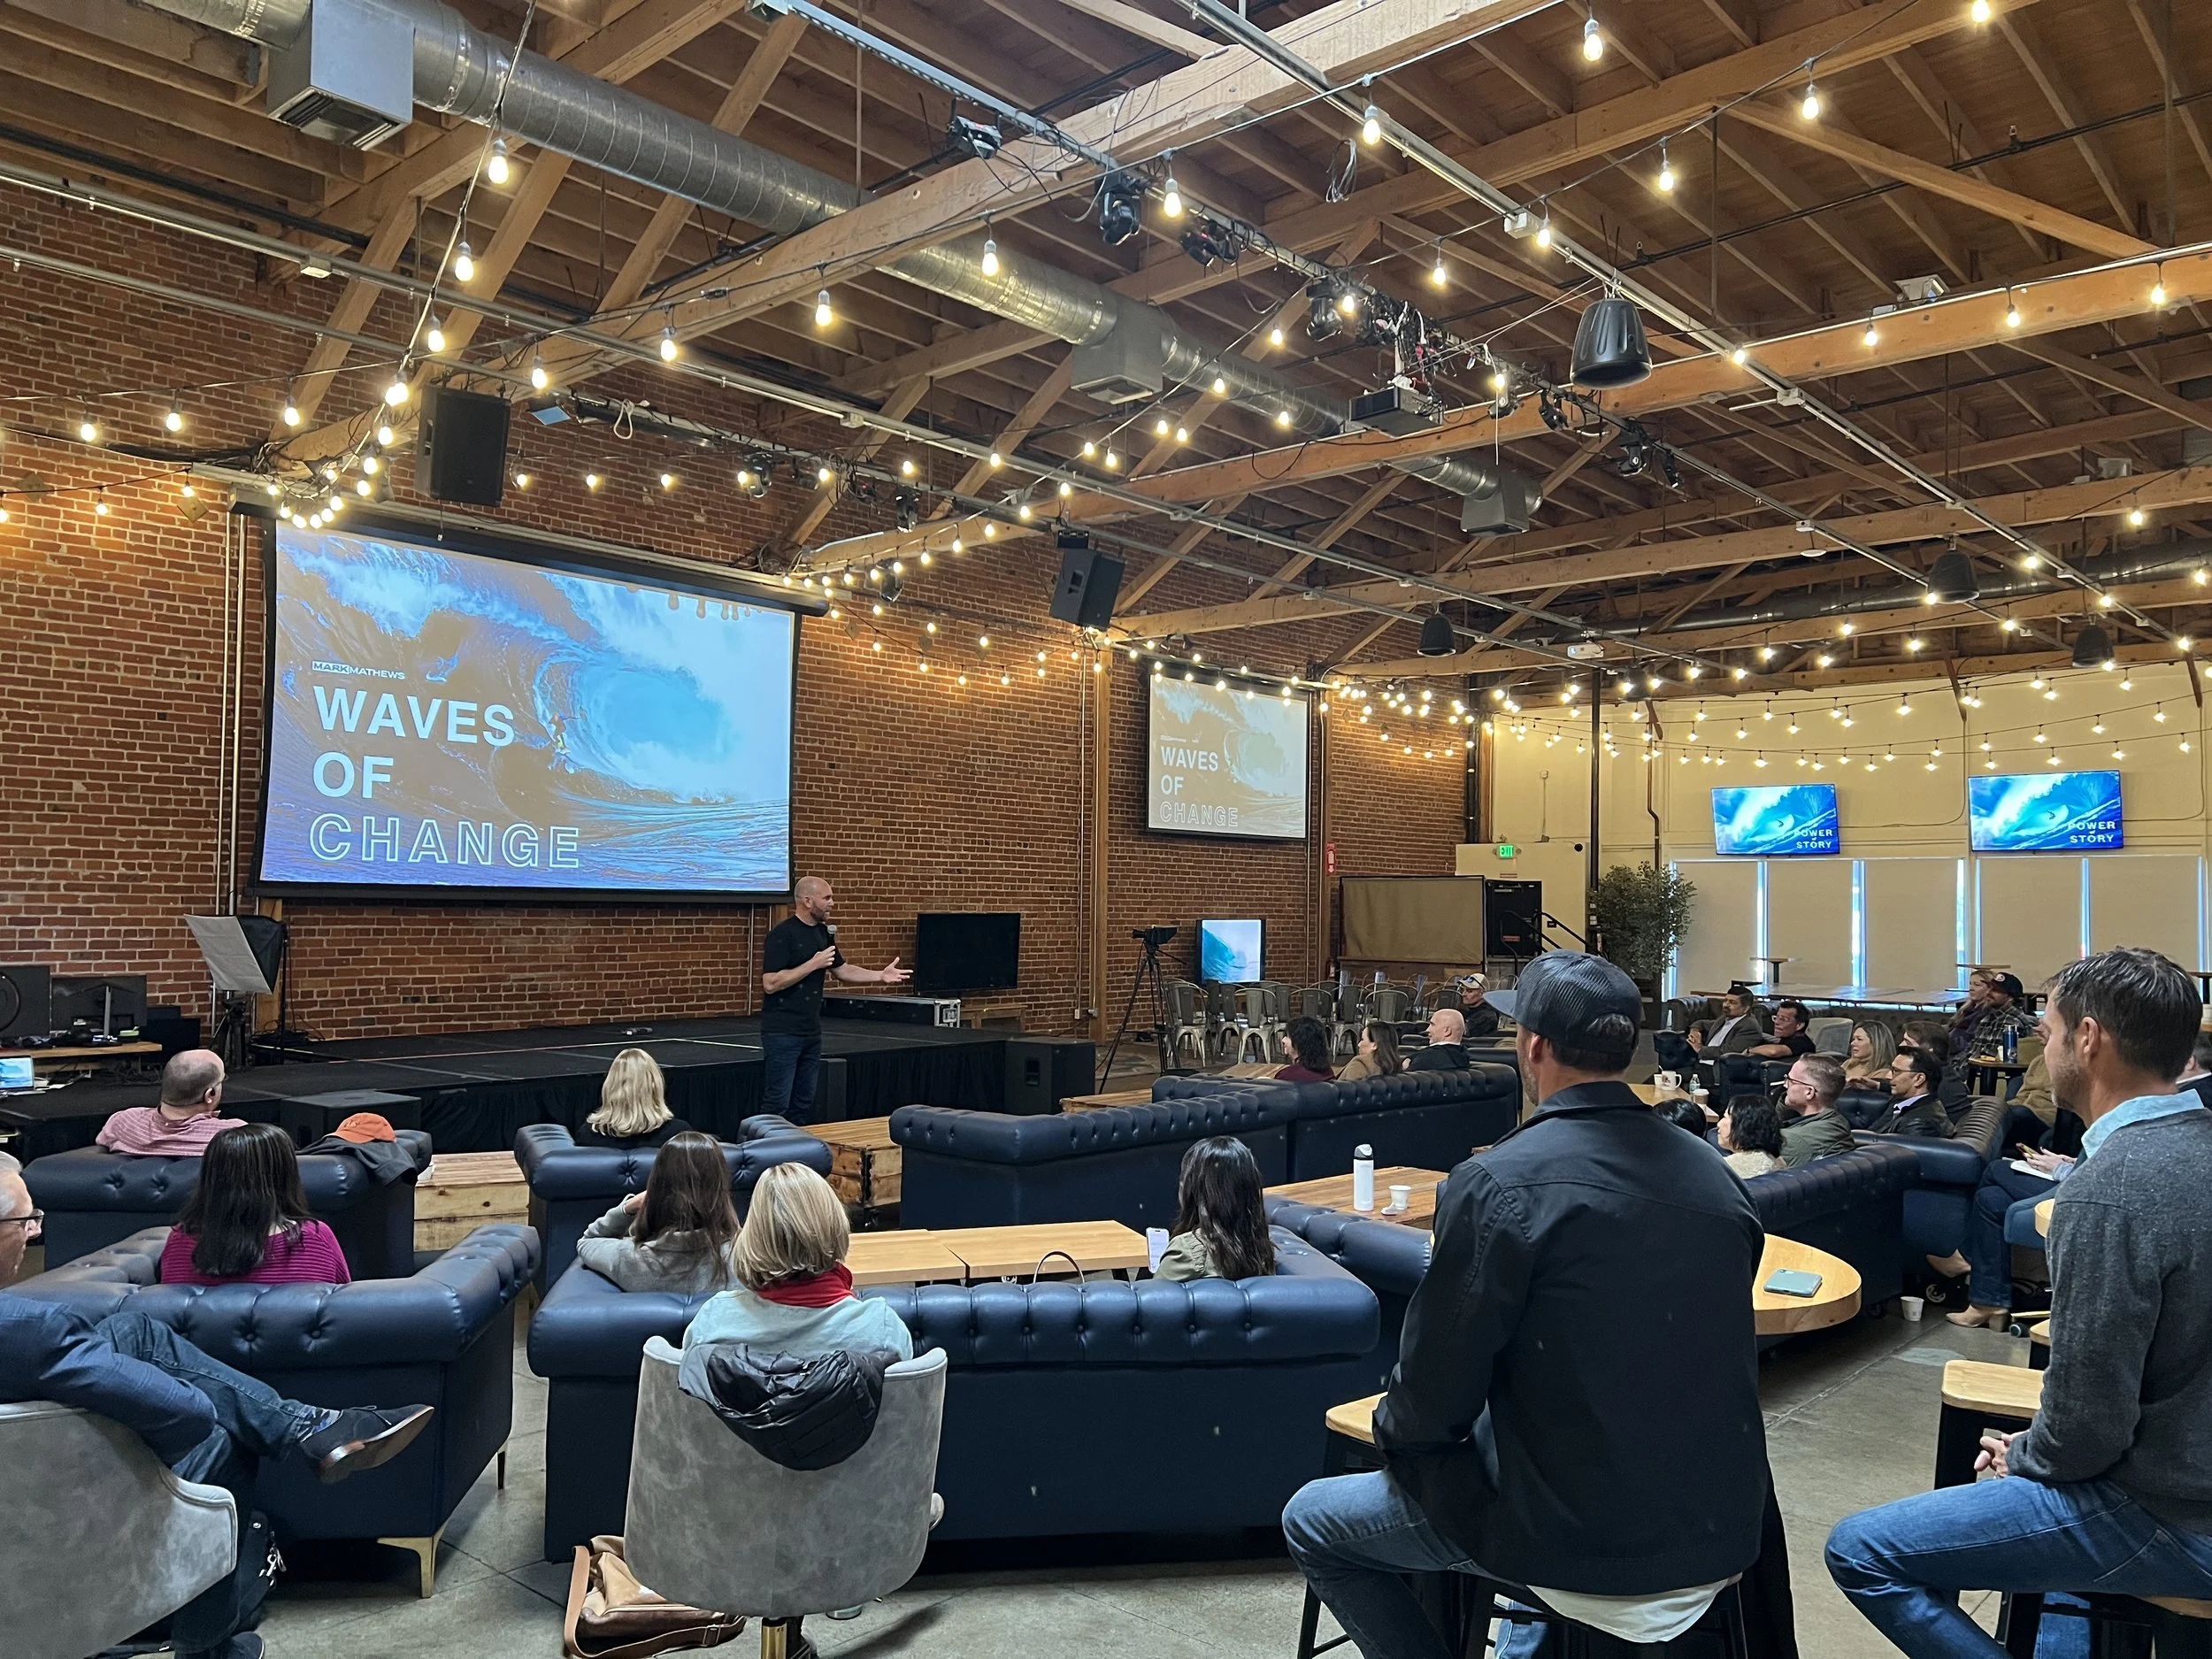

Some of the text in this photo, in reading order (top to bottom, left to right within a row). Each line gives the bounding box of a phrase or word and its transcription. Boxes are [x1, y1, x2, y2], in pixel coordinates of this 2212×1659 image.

[312, 685, 516, 748] WAVES
[1160, 746, 1218, 772] WAVES
[312, 751, 395, 799] OF
[1160, 774, 1184, 795] OF
[1160, 801, 1239, 827] CHANGE
[2067, 820, 2116, 830] POWER
[309, 812, 580, 870] CHANGE
[1794, 828, 1832, 837] POWER
[2070, 833, 2114, 843] STORY
[1499, 845, 1513, 856] EXIT
